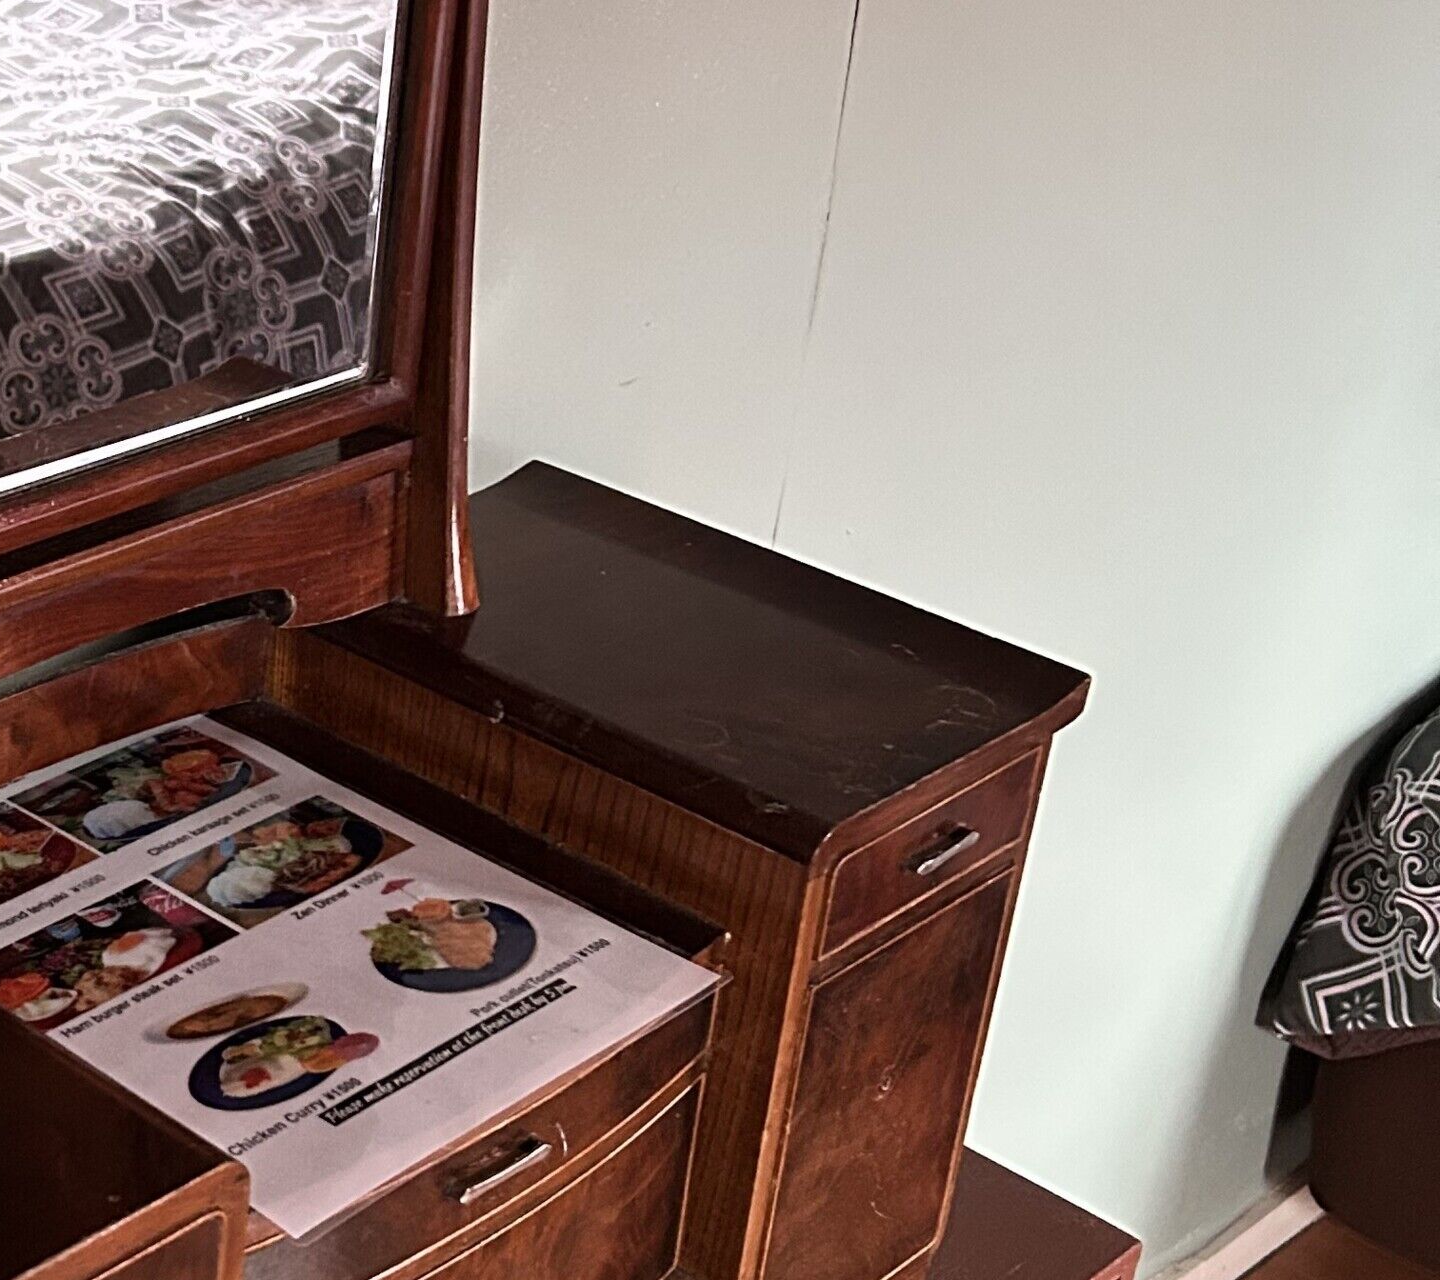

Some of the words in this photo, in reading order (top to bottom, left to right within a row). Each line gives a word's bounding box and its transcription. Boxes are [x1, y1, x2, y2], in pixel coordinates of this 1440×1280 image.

[147, 834, 193, 856] Chicken
[312, 889, 349, 909] Dinner
[61, 1020, 93, 1037] Ham
[91, 1000, 131, 1022] burger
[131, 984, 164, 1003] steak
[163, 974, 184, 987] set
[325, 1099, 364, 1123] Please
[363, 1081, 394, 1103] make
[393, 1048, 453, 1087] reservation
[452, 1040, 466, 1053] at
[463, 1030, 483, 1044] the
[480, 1014, 510, 1035] front
[227, 1121, 287, 1156] Chicken
[284, 1098, 327, 1123] Curry
[323, 1077, 362, 1100] ¥1500
